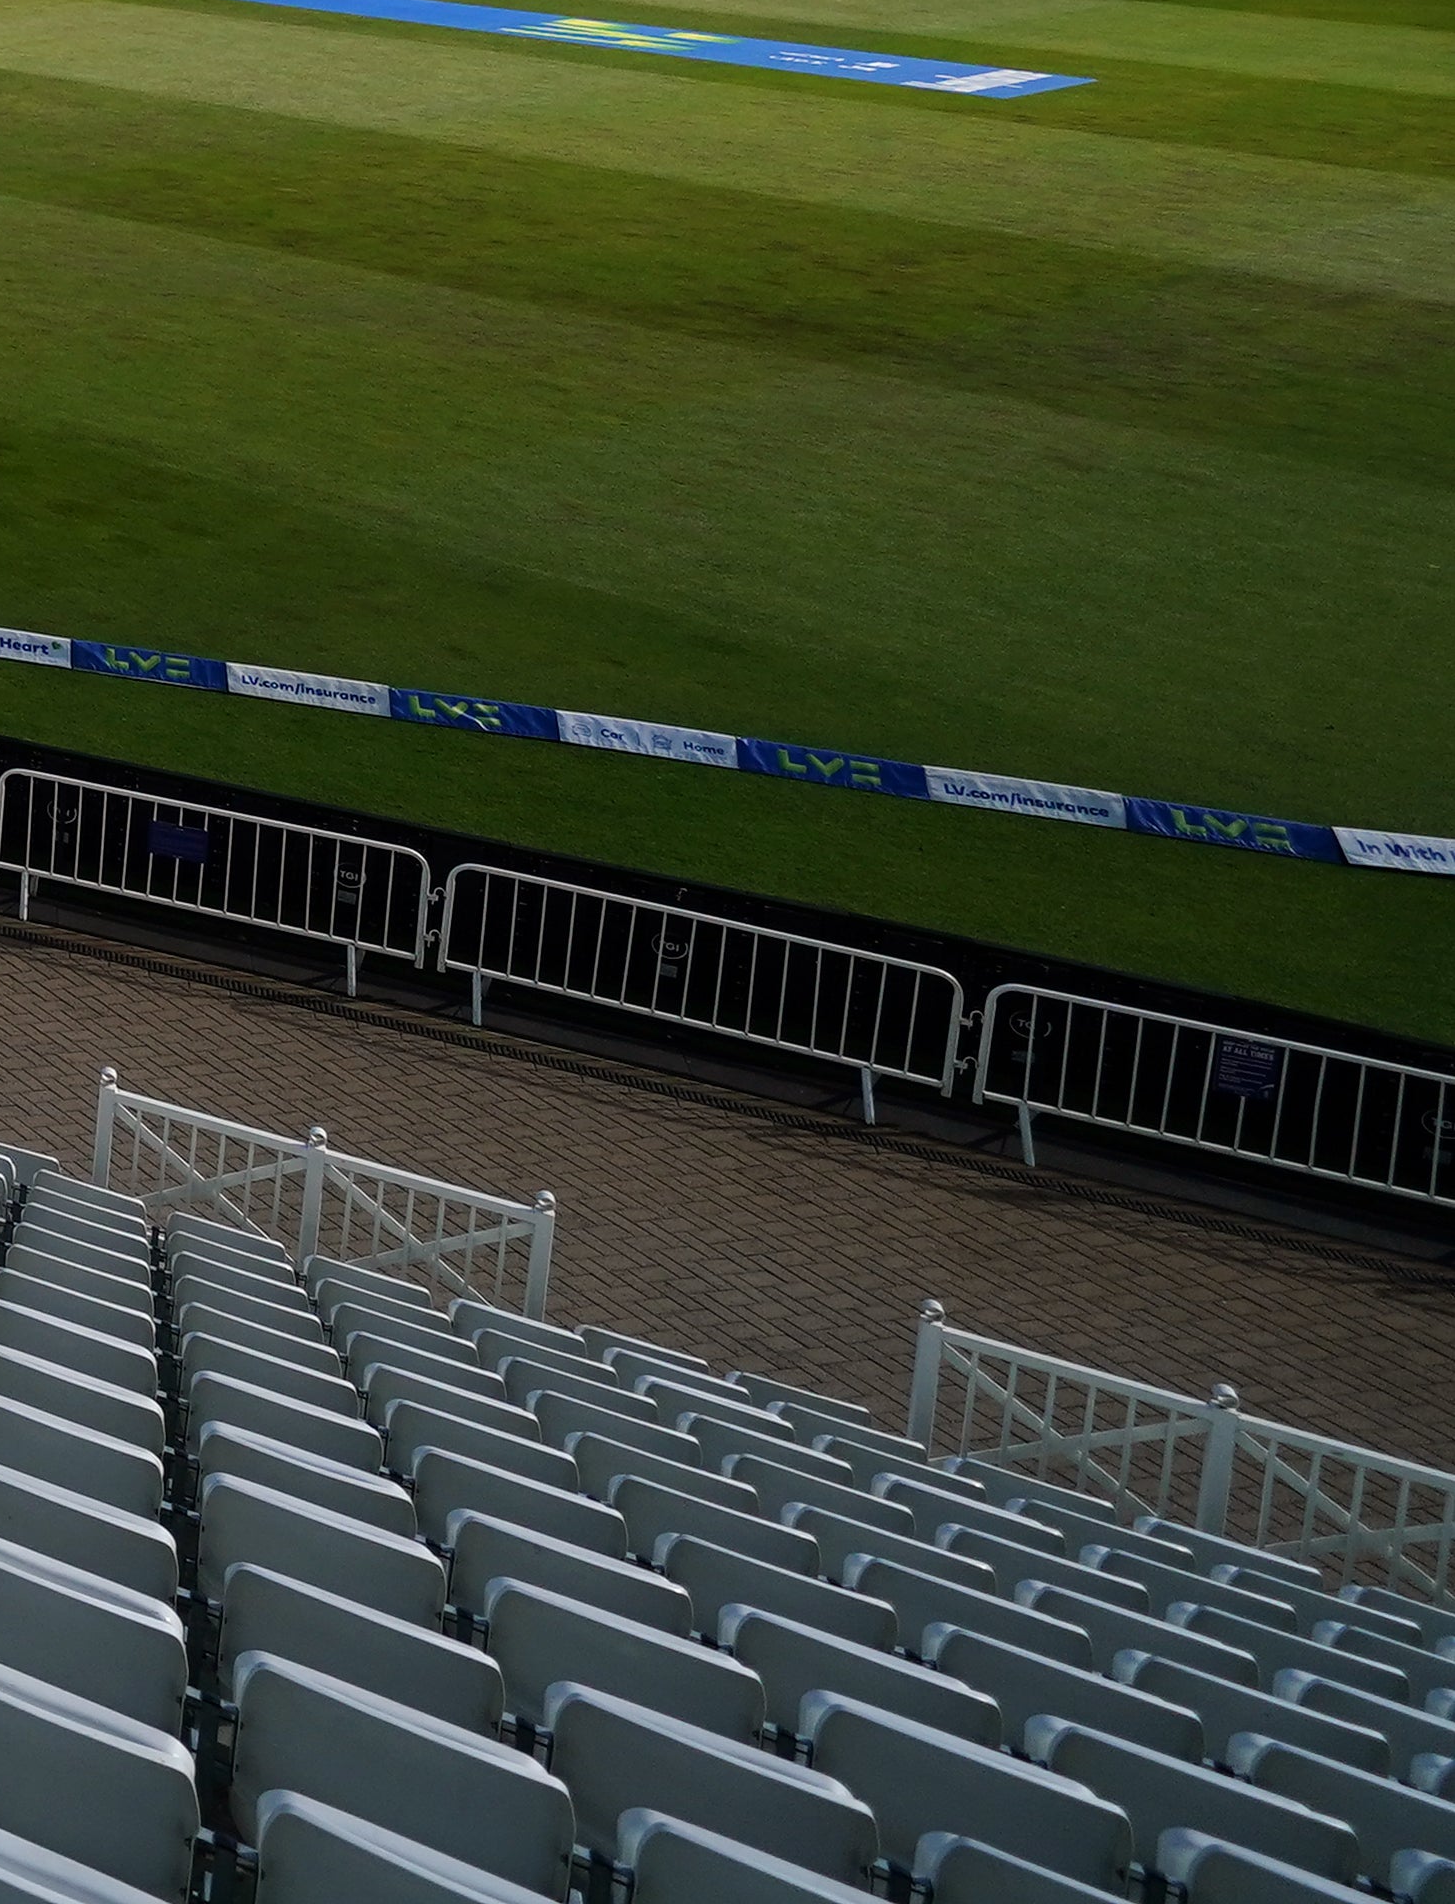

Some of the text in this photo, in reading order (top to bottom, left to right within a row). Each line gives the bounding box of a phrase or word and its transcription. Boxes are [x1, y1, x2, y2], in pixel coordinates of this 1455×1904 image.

[241, 675, 377, 705] LV.com/insurance
[599, 727, 725, 756] Car Home
[943, 783, 1110, 818] LV.com/insurance
[1356, 839, 1447, 862] In With
[340, 869, 359, 882] TGI
